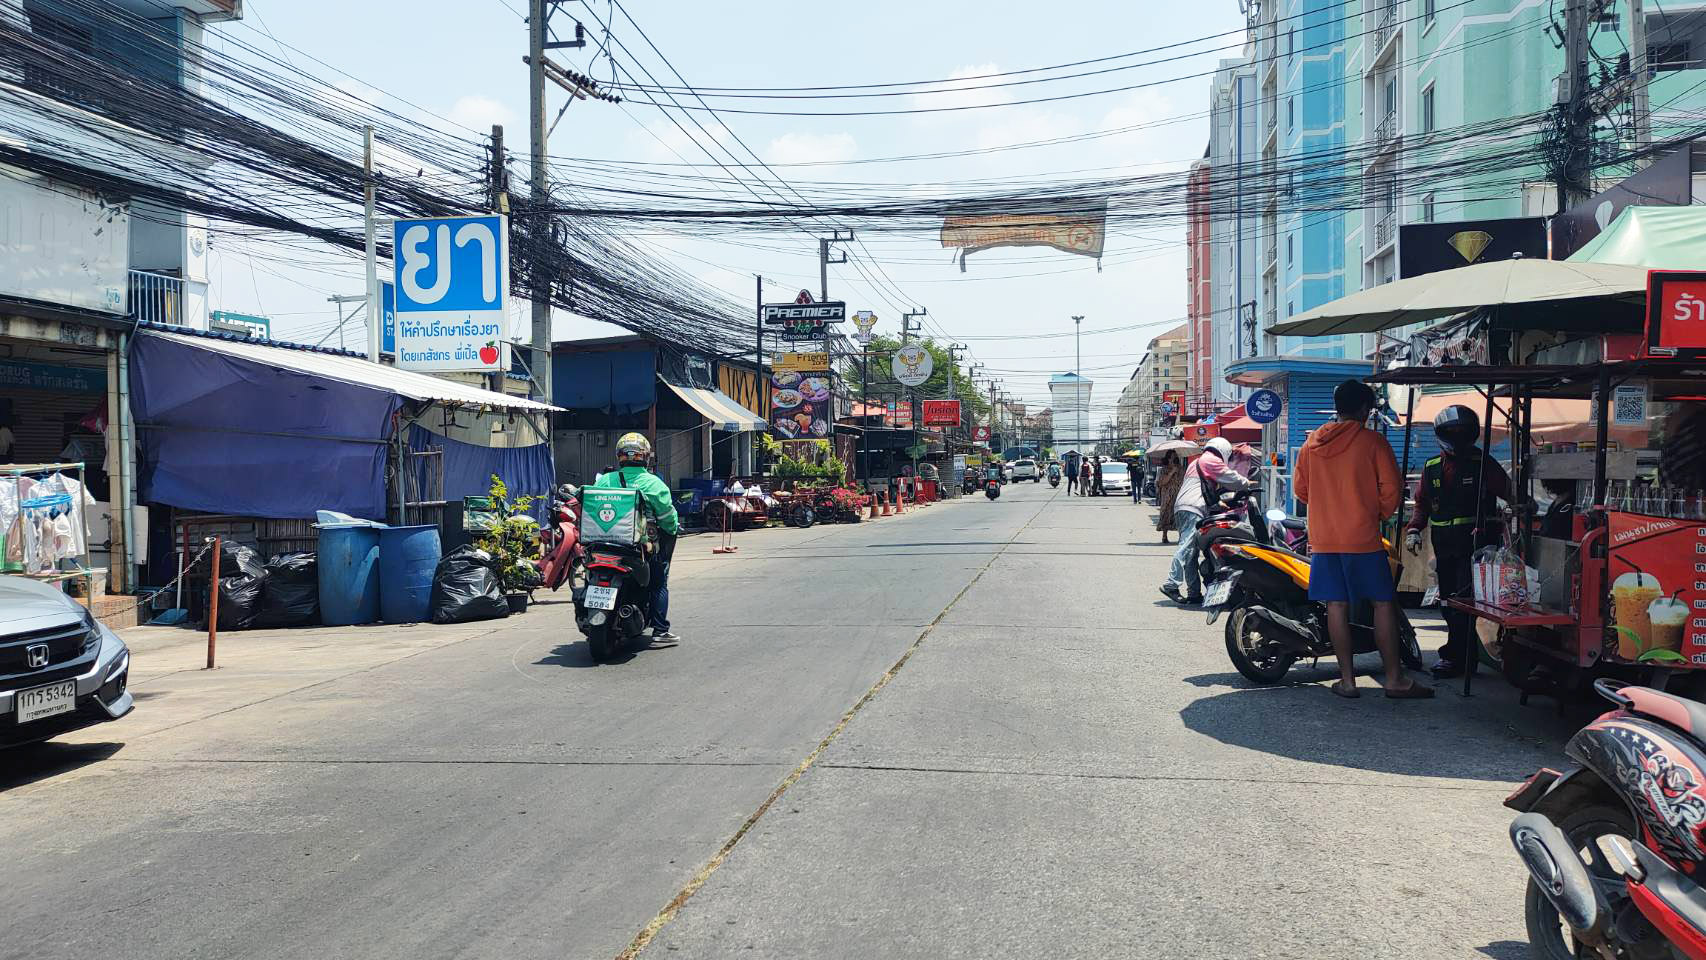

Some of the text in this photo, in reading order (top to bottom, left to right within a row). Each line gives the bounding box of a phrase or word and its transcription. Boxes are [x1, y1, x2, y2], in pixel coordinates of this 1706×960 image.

[402, 223, 496, 304] ยา
[766, 307, 843, 320] PREMIER
[400, 315, 499, 338] ให้คำปรึกษาเรื่องยา
[812, 332, 827, 340] Club
[401, 343, 478, 362] โดยเภสัชกร พี่เปิ้ล
[797, 353, 828, 362] Friend
[21, 683, 74, 708] 1กร 5342
